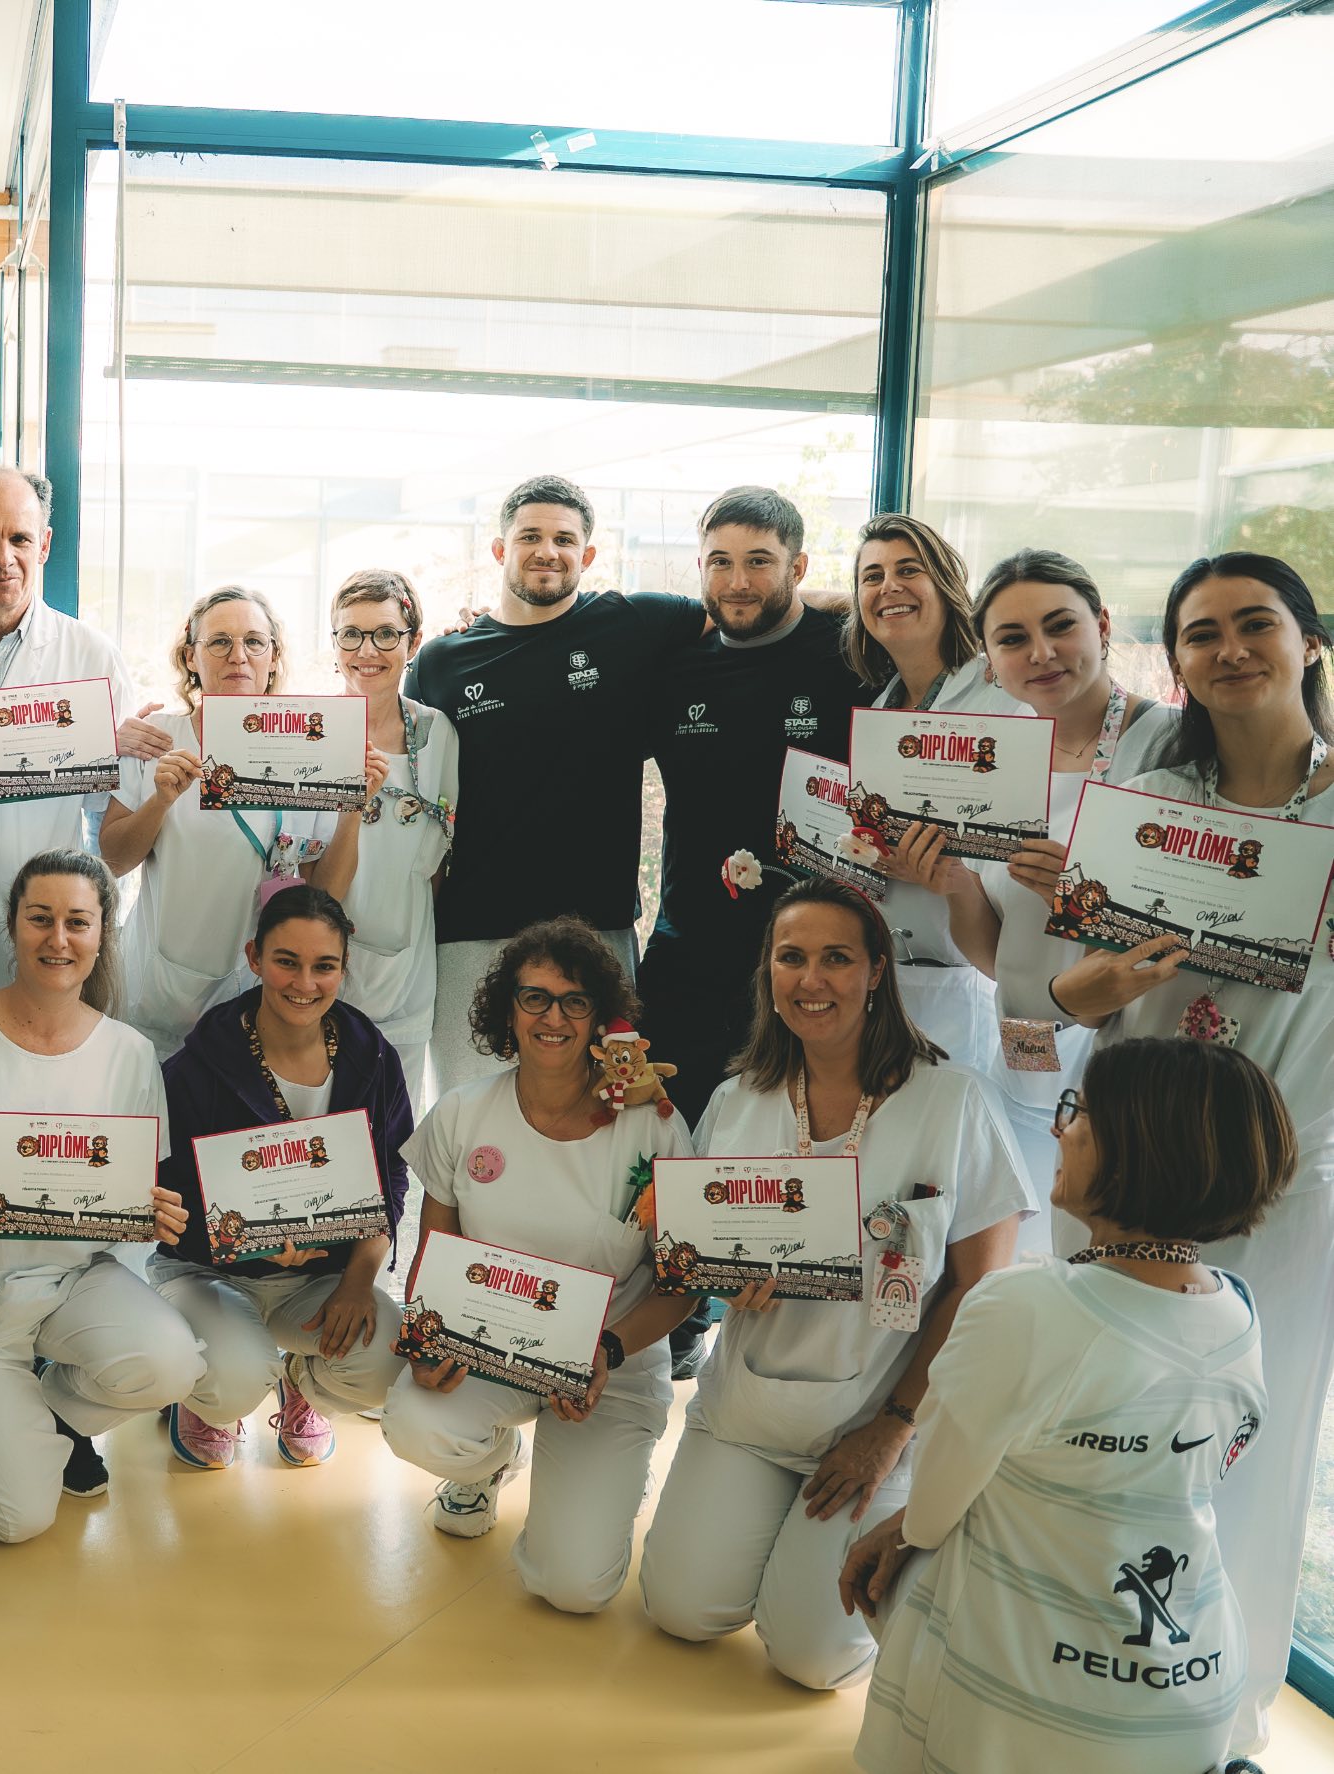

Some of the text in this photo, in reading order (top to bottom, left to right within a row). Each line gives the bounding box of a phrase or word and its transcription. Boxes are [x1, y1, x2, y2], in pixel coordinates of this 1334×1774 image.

[567, 667, 599, 681] STADE
[569, 675, 600, 685] TOULOUSAIN
[10, 700, 58, 725] DIPLÔME
[259, 710, 309, 734] DIPLÔME
[456, 702, 505, 720] STADE TOULOUSAIN
[784, 718, 818, 726] STADE
[918, 732, 977, 762] DIPLÔME
[818, 779, 847, 805] DIPLÔME
[1162, 825, 1238, 865] DIPLÔME
[35, 1132, 91, 1159] DIPLÔME
[258, 1140, 312, 1168] DIPLÔME
[726, 1175, 785, 1204] DIPLÔME
[484, 1265, 541, 1299] DIPLÔME
[1064, 1432, 1149, 1453] IRBUS
[1052, 1641, 1222, 1690] PEUGEOT
